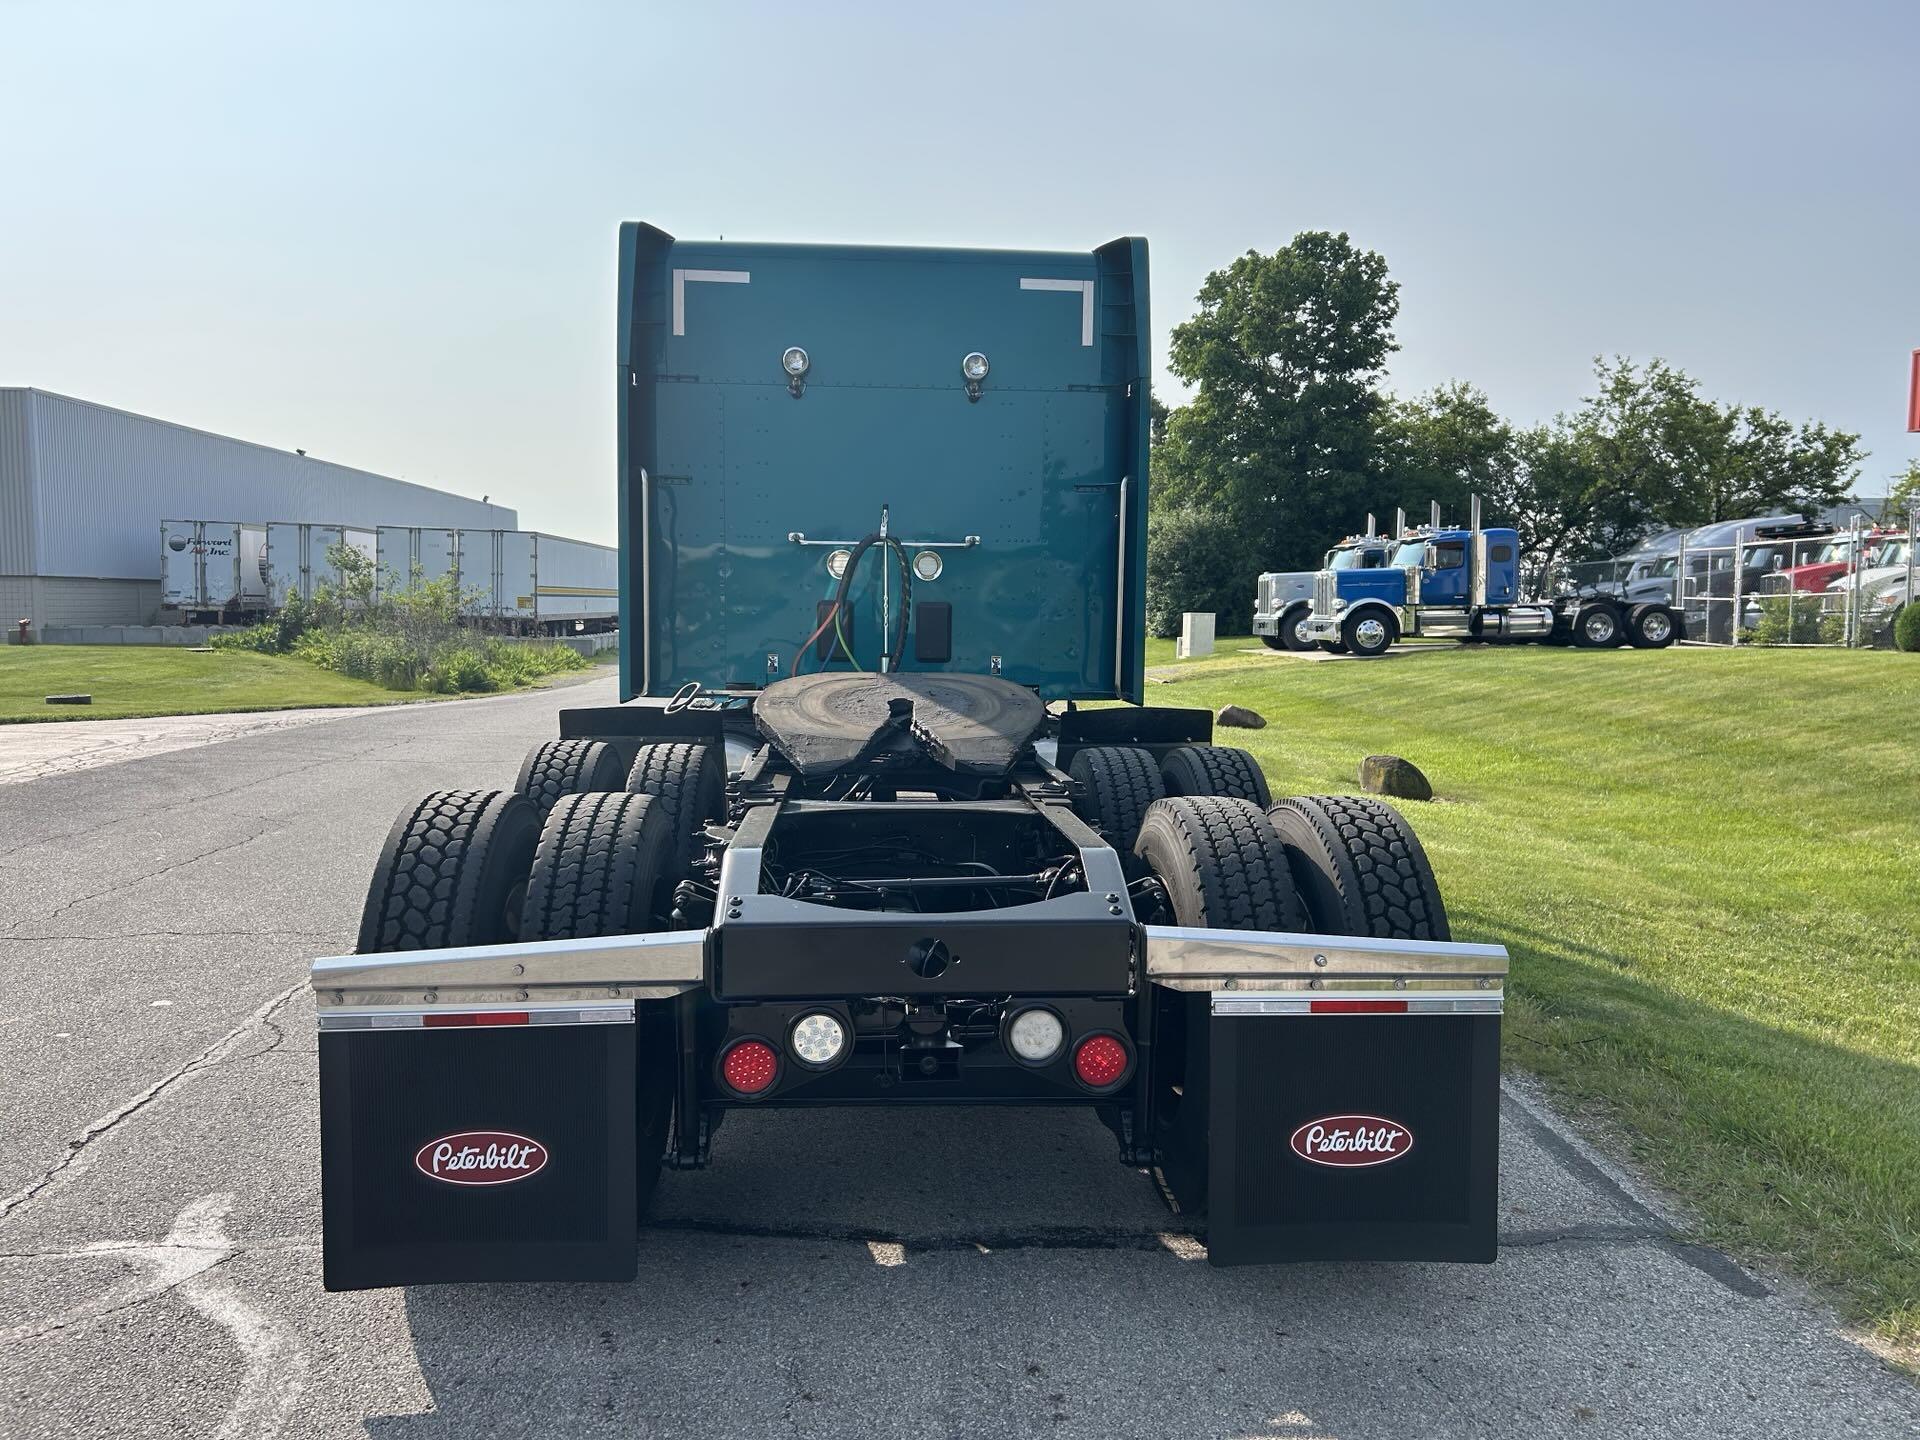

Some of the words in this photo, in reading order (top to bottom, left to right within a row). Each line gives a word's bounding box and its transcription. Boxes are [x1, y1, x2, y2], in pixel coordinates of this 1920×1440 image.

[186, 537, 232, 546] Forward
[1306, 1125, 1403, 1154] Peterbilt
[432, 1142, 537, 1173] Peterbilt
